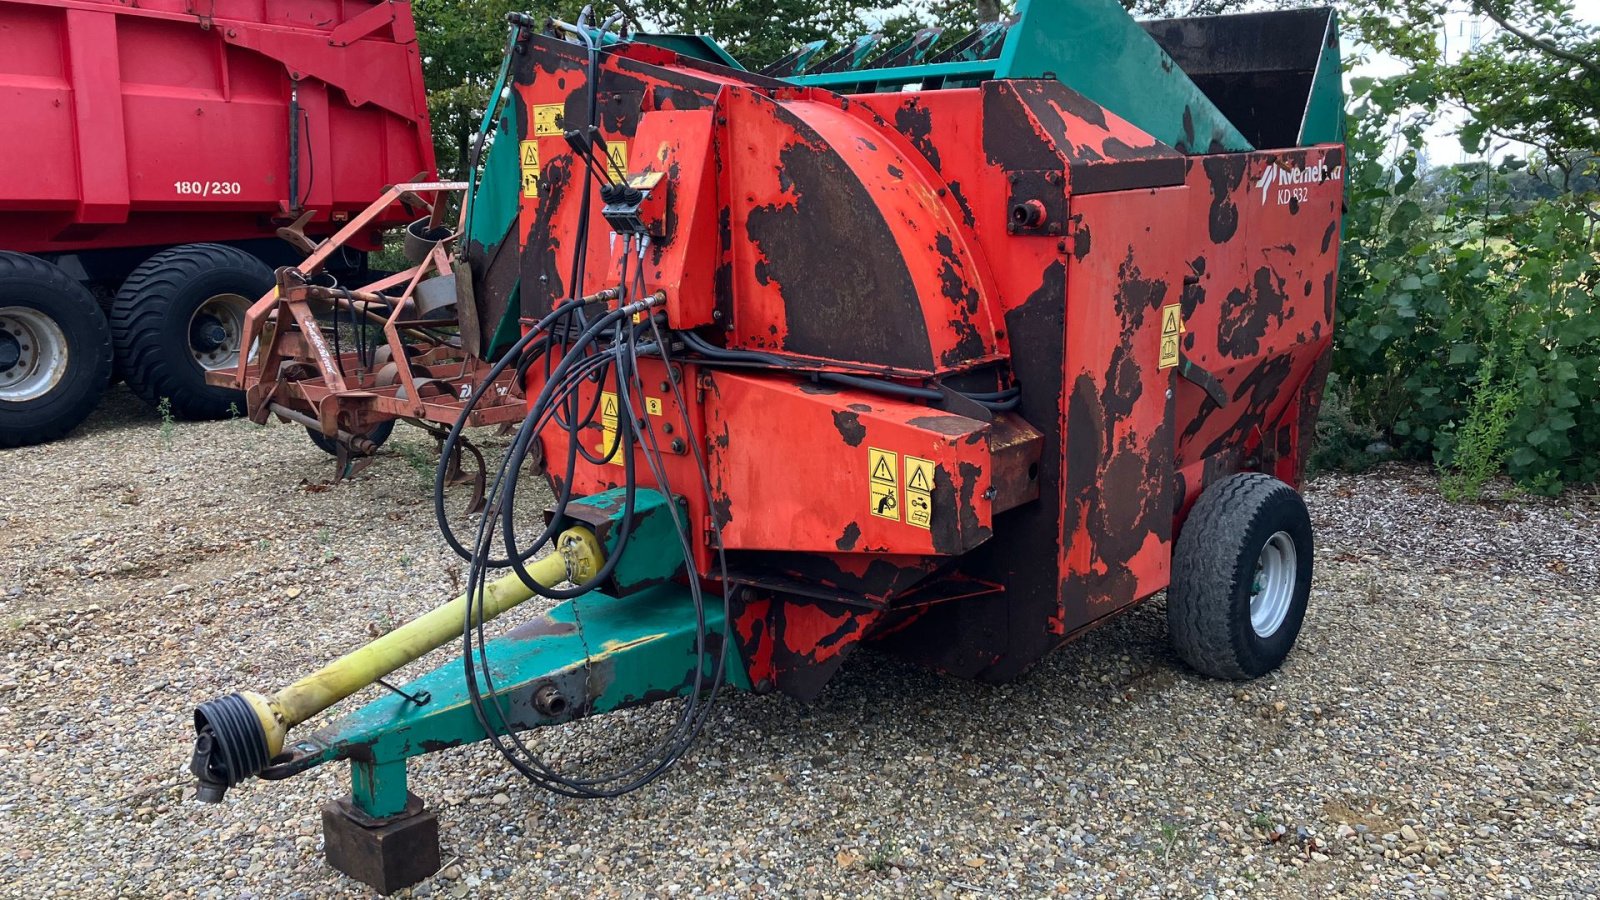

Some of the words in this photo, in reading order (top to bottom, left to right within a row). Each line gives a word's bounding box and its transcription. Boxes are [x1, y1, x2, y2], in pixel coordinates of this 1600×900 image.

[174, 181, 241, 197] 180/230
[1277, 188, 1291, 205] KD
[1293, 187, 1308, 203] 832
